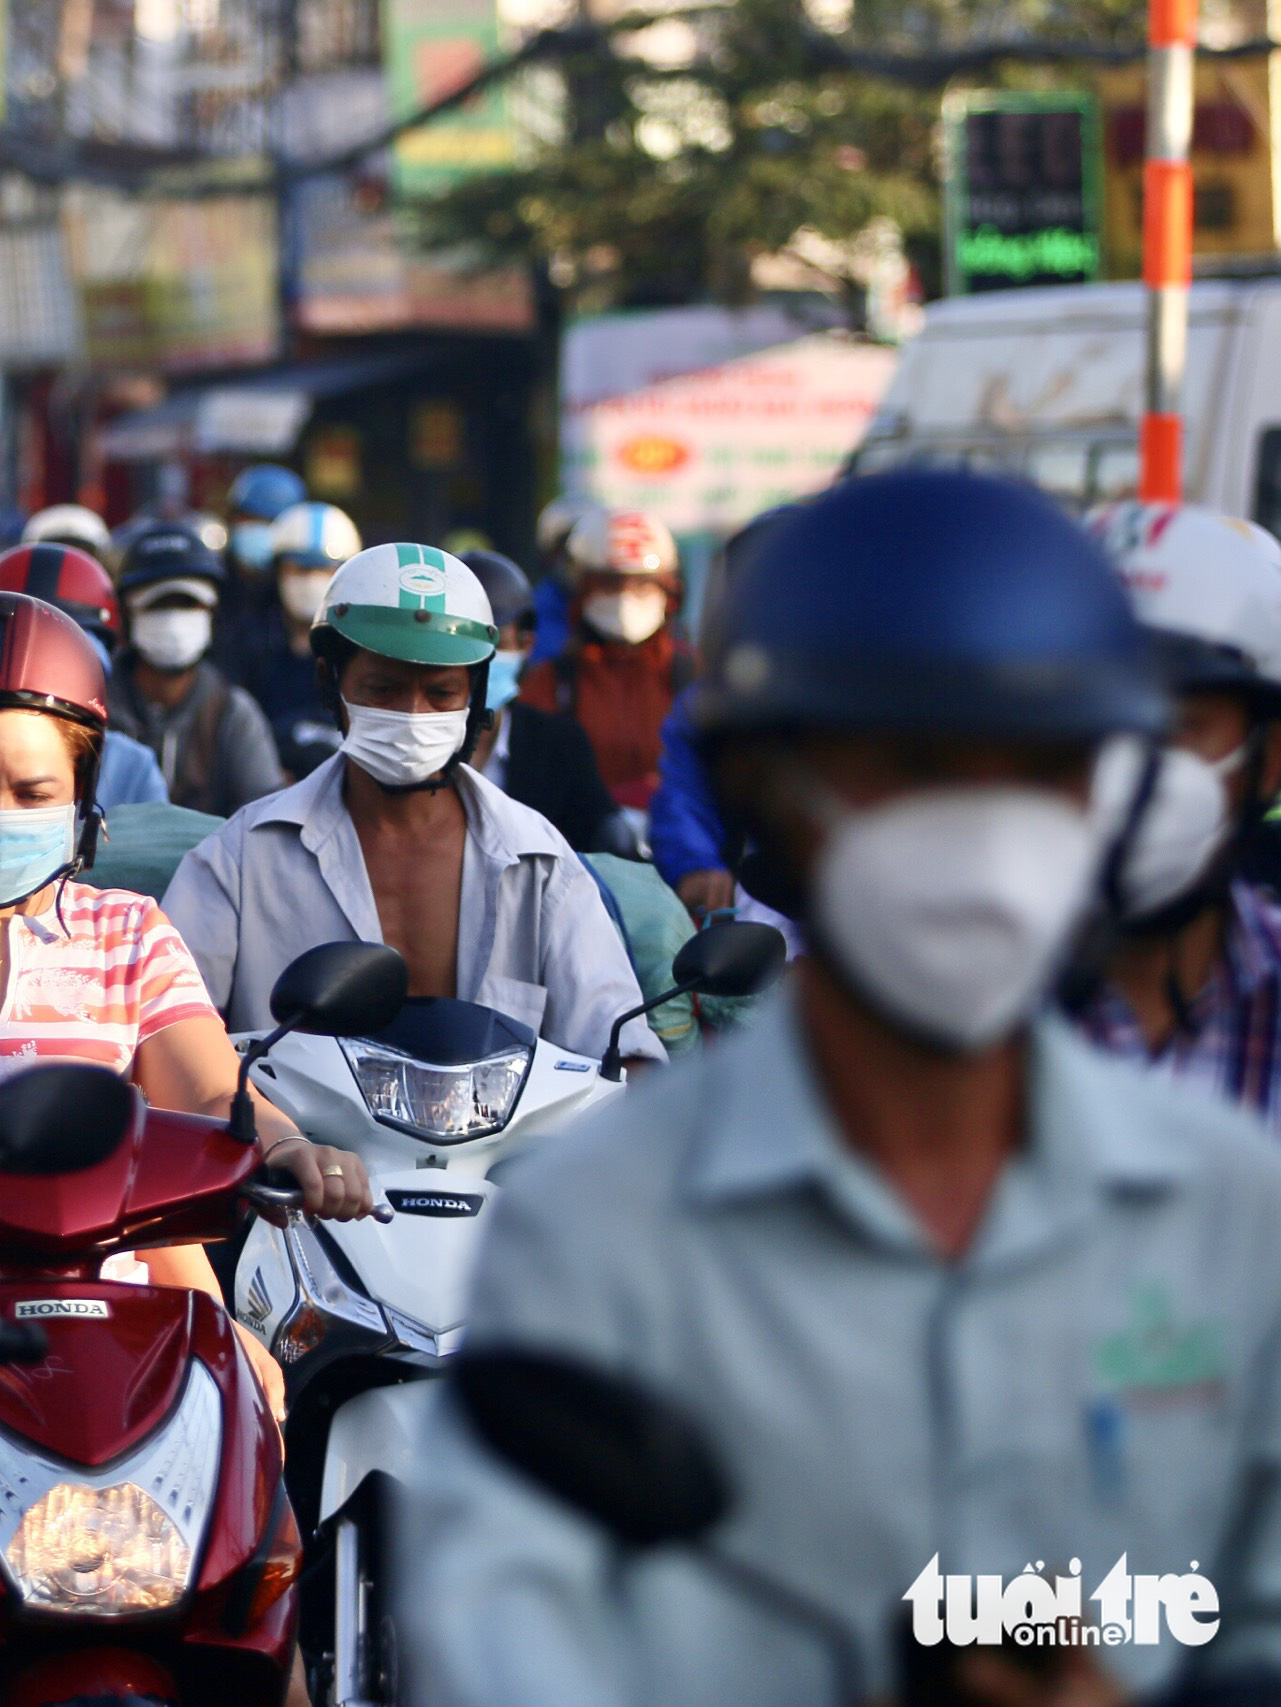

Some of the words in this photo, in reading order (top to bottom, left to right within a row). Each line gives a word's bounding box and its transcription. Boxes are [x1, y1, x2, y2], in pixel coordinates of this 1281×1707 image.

[401, 1198, 472, 1211] HONDA
[18, 1303, 105, 1315] HONDA
[235, 1308, 266, 1335] HONDA
